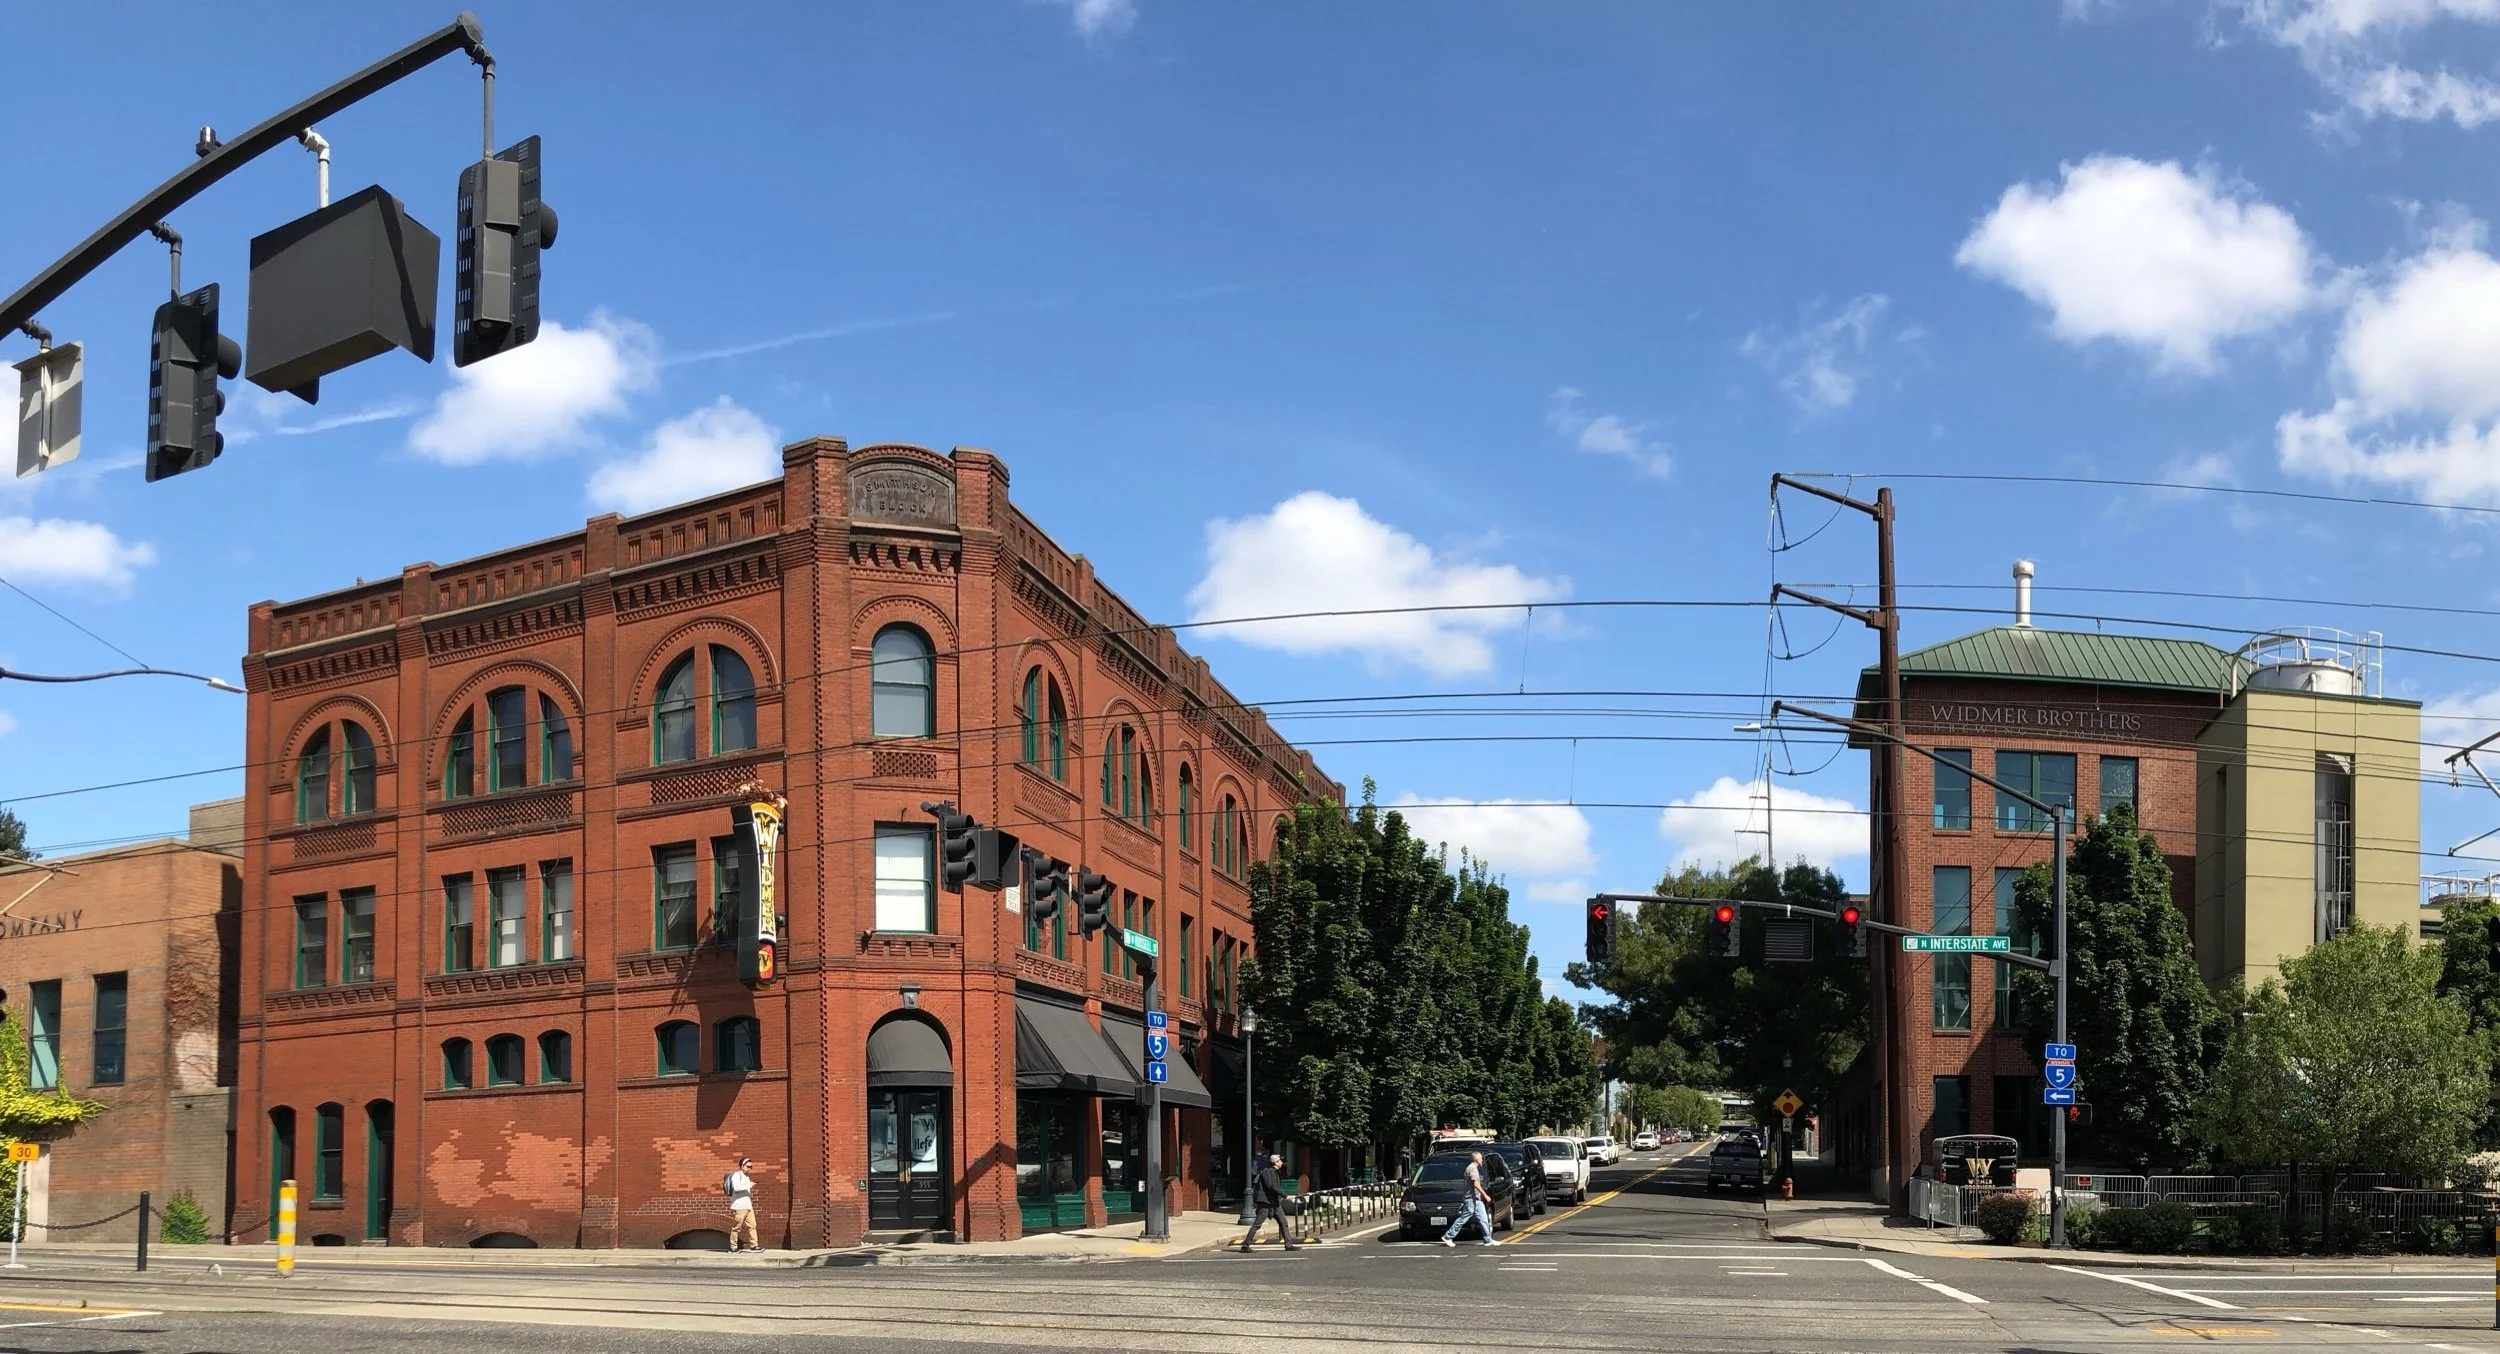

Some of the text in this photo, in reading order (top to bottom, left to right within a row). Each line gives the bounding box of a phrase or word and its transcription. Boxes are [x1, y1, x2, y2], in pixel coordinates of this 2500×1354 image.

[865, 479, 936, 498] SMITHSON
[879, 501, 926, 514] BLOCK
[1931, 705, 2141, 731] WIDMER BROTHERS
[1921, 938, 2007, 950] N INTERSTATE AVE
[1153, 1015, 1162, 1025] TO
[1154, 1036, 1162, 1054] 5
[2054, 1047, 2067, 1057] TO
[2055, 1068, 2065, 1083] 5
[16, 1146, 32, 1158] 30
[1965, 1157, 1996, 1178] W
[919, 1181, 931, 1189] 955
